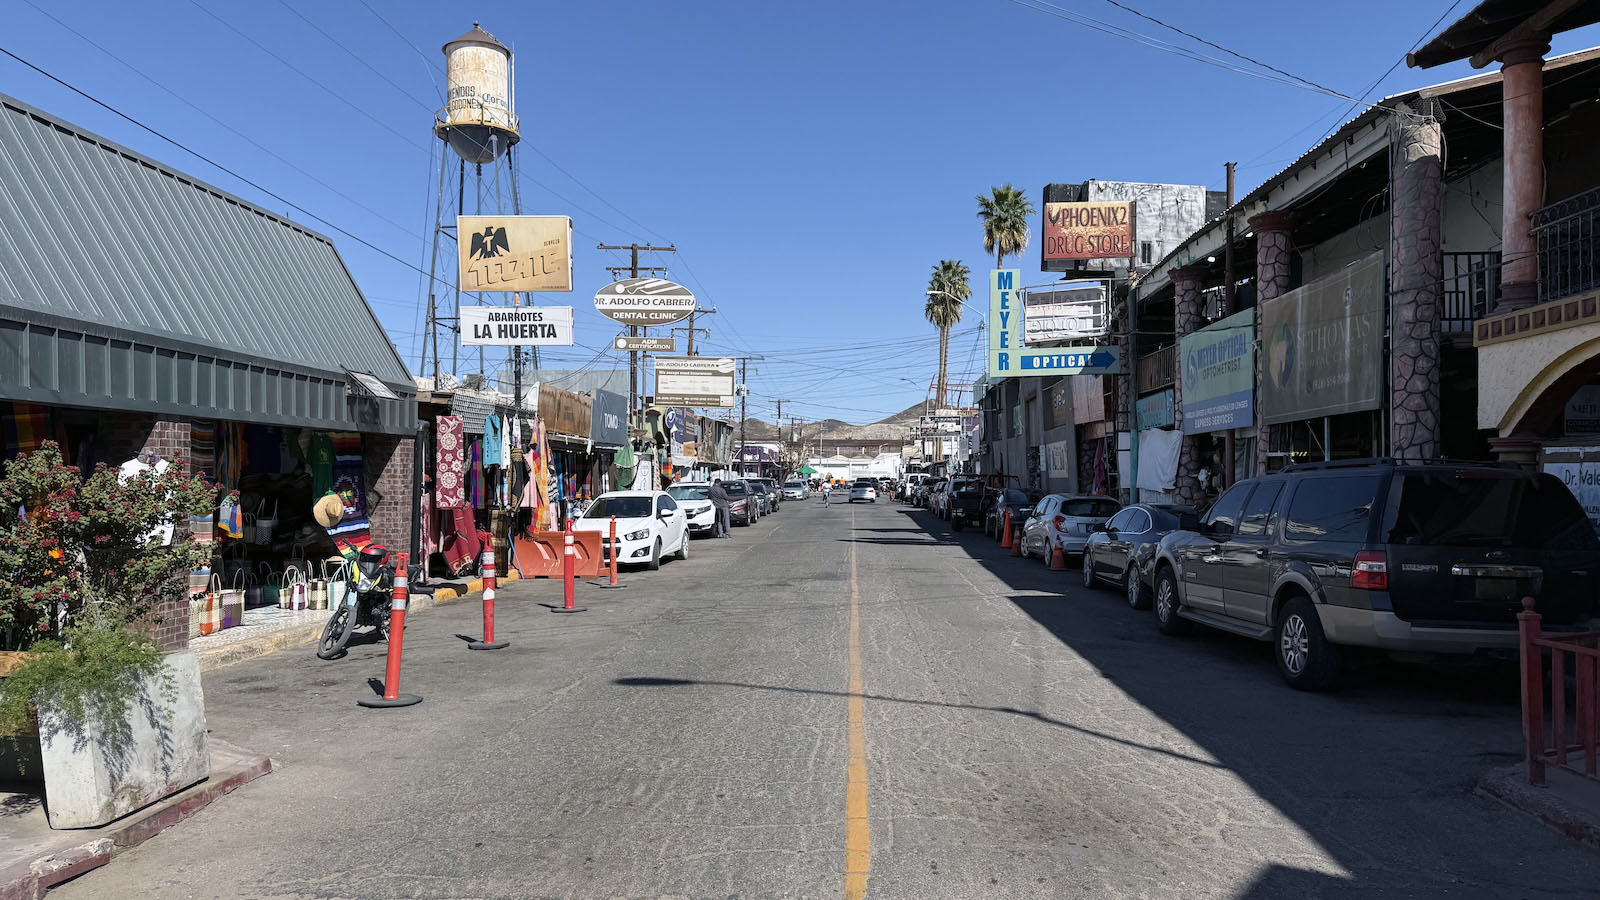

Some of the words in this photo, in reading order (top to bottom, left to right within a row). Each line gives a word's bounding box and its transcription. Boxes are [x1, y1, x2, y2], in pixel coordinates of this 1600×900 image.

[1047, 235, 1084, 254] DRUG
[1088, 234, 1129, 254] STORE
[609, 297, 651, 306] ADOLFO
[652, 298, 695, 306] CABRERA
[488, 312, 543, 322] ABARROTES
[613, 312, 647, 320] DENTAL
[649, 312, 677, 320] CLINIC
[997, 271, 1013, 371] MEYER
[474, 324, 492, 339] LA
[497, 323, 557, 339] HUERTA
[1033, 355, 1094, 368] OPTICAL
[1565, 469, 1577, 486] Dr.
